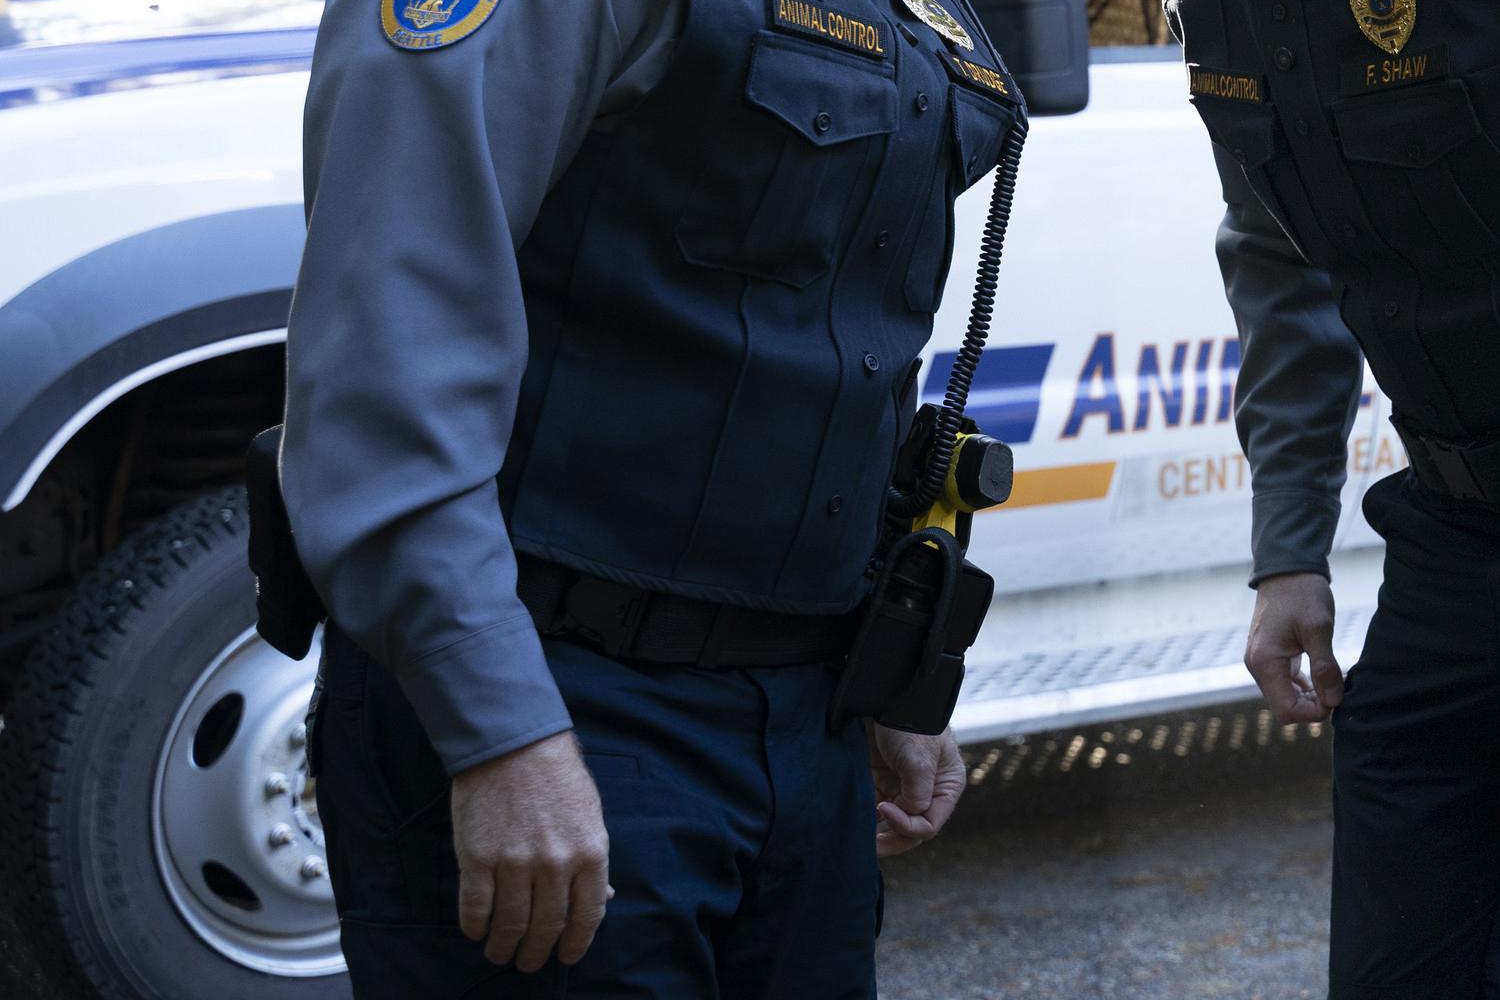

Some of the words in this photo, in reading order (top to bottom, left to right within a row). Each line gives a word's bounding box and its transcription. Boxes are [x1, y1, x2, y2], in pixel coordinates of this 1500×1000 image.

[392, 26, 443, 47] SEATTLE
[827, 12, 884, 53] CONTROL
[1365, 64, 1377, 86] F.
[1381, 55, 1428, 84] SHAW
[1158, 452, 1247, 500] CENT
